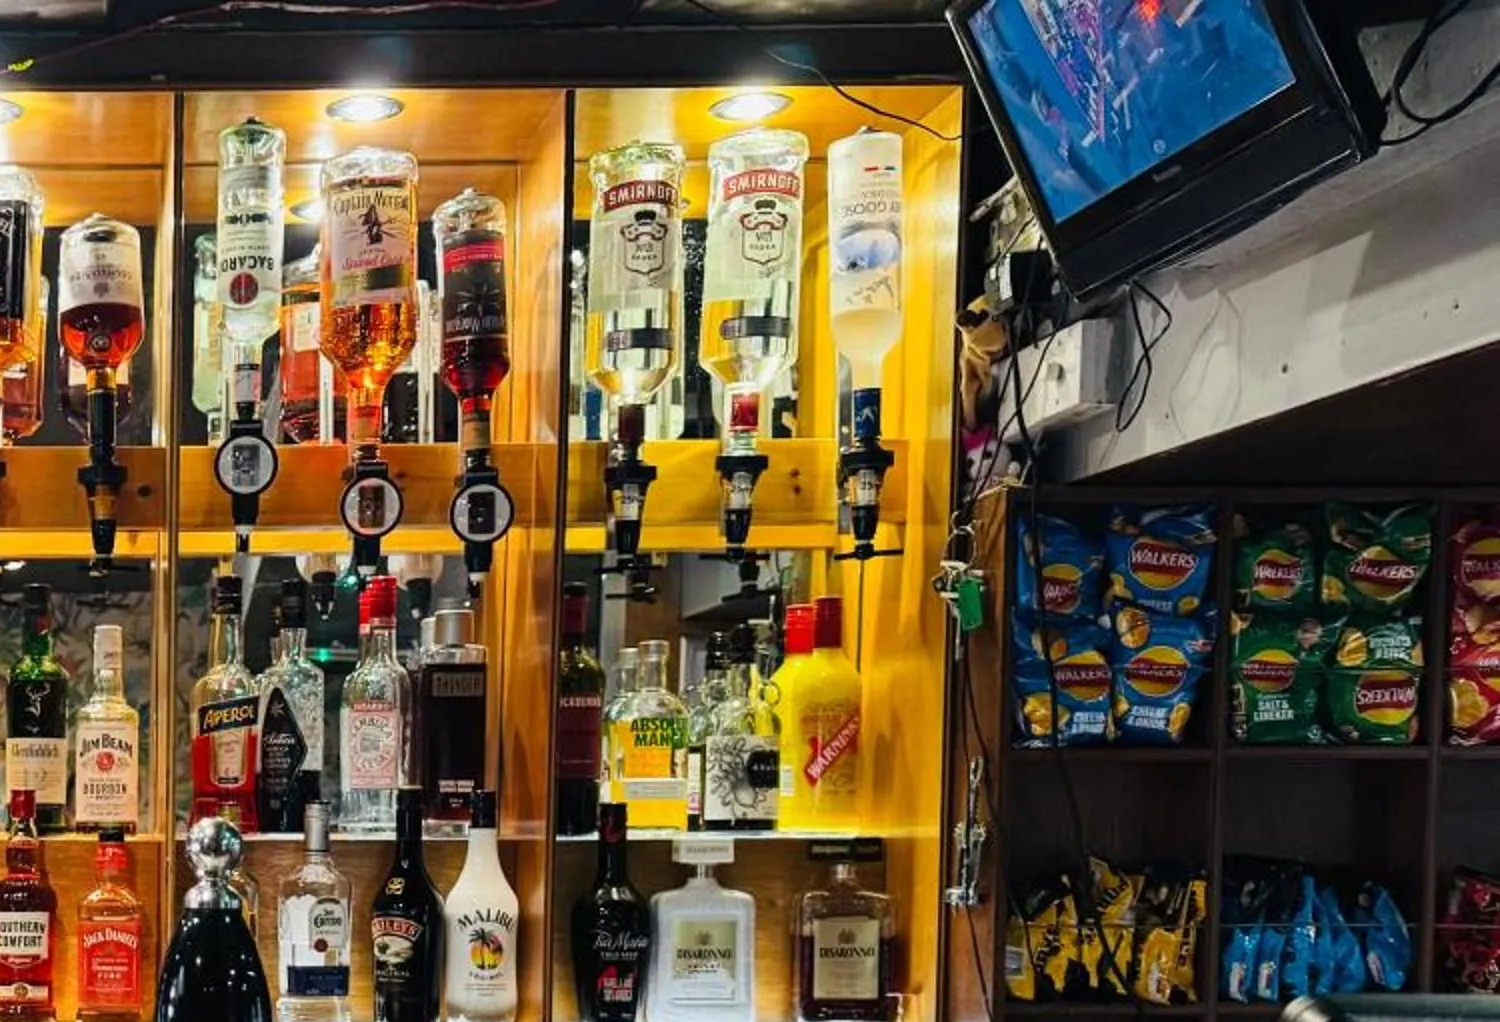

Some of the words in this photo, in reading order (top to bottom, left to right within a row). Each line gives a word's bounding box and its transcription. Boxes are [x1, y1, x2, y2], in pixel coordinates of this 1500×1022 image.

[728, 171, 799, 194] SMIRNOFF
[608, 184, 677, 207] SMIRNOFF
[1131, 549, 1197, 569] WALKERS
[80, 737, 101, 758] JIM
[101, 733, 133, 757] BEAM
[456, 907, 515, 932] MALIBU
